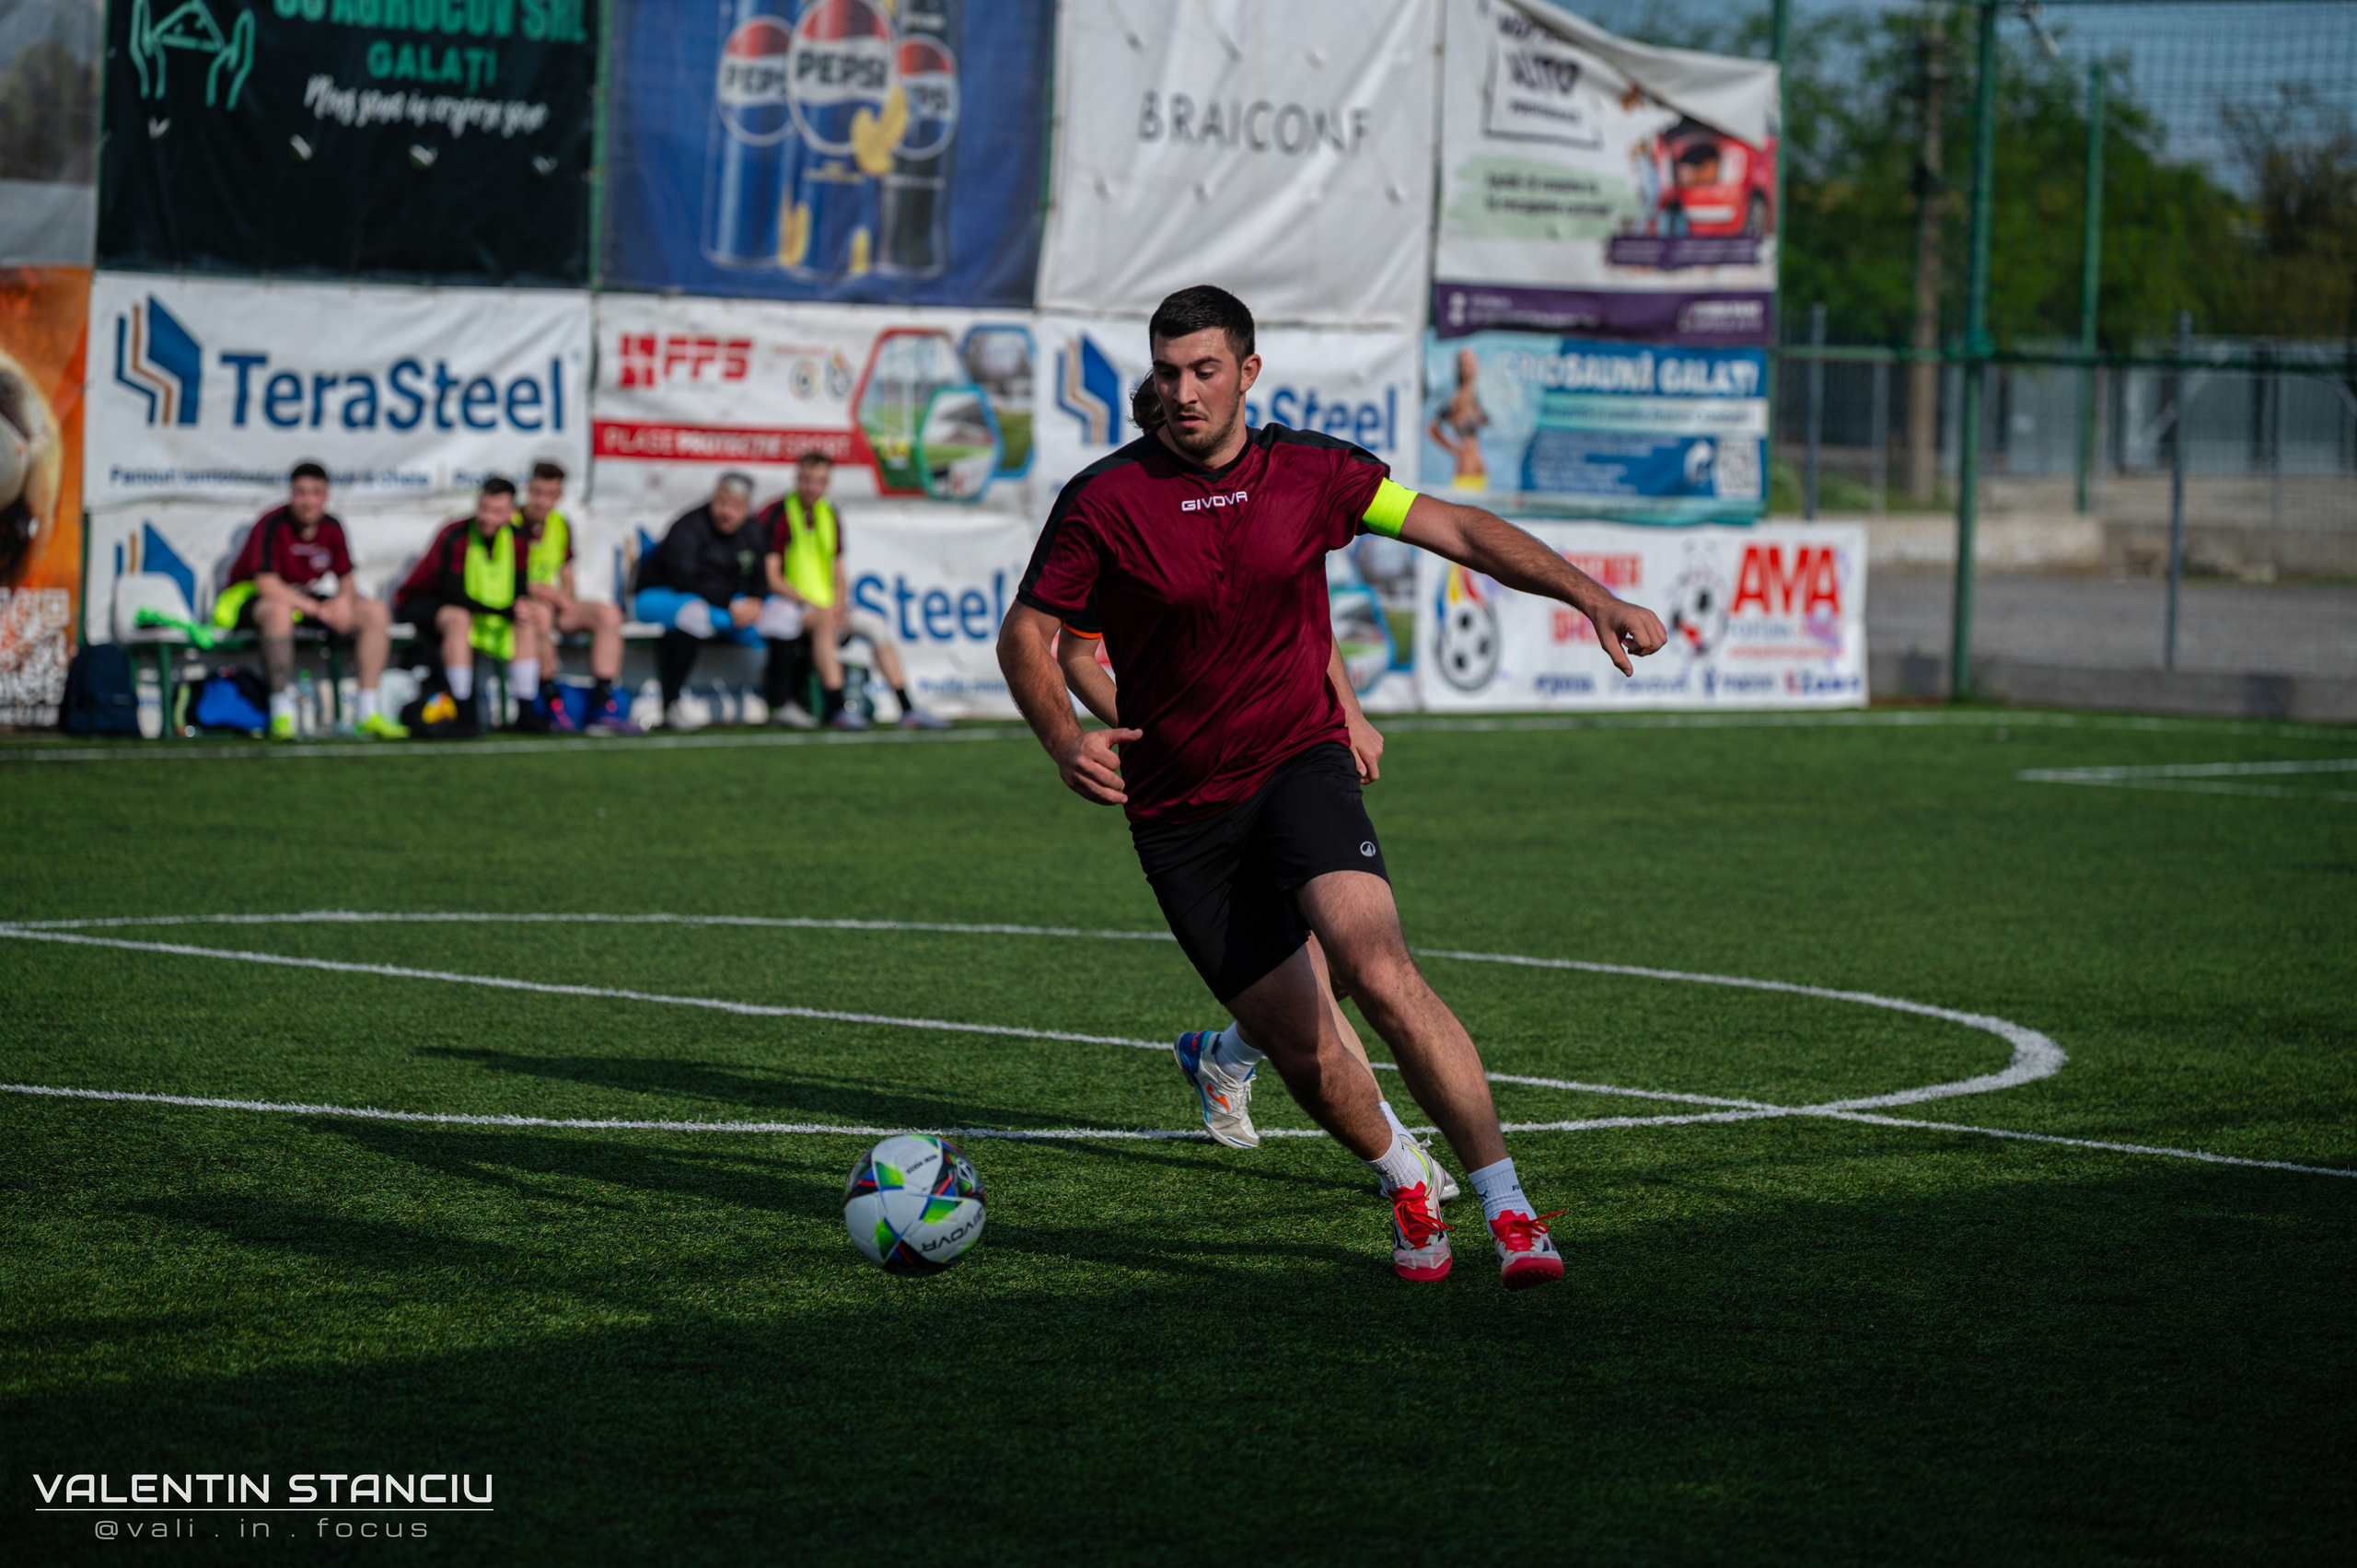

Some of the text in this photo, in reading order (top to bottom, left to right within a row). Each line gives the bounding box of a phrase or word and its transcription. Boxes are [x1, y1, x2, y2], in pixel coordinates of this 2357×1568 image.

[724, 64, 789, 93] PEPS
[796, 50, 888, 88] PEPSI
[1137, 89, 1371, 156] BRAICONF
[218, 353, 564, 432] TeraSteel
[1246, 384, 1397, 449] aSteel
[602, 424, 673, 457] PLASE
[1180, 490, 1248, 512] GIVOVA
[851, 570, 1006, 642] Steel
[922, 1206, 983, 1252] GIVOVA
